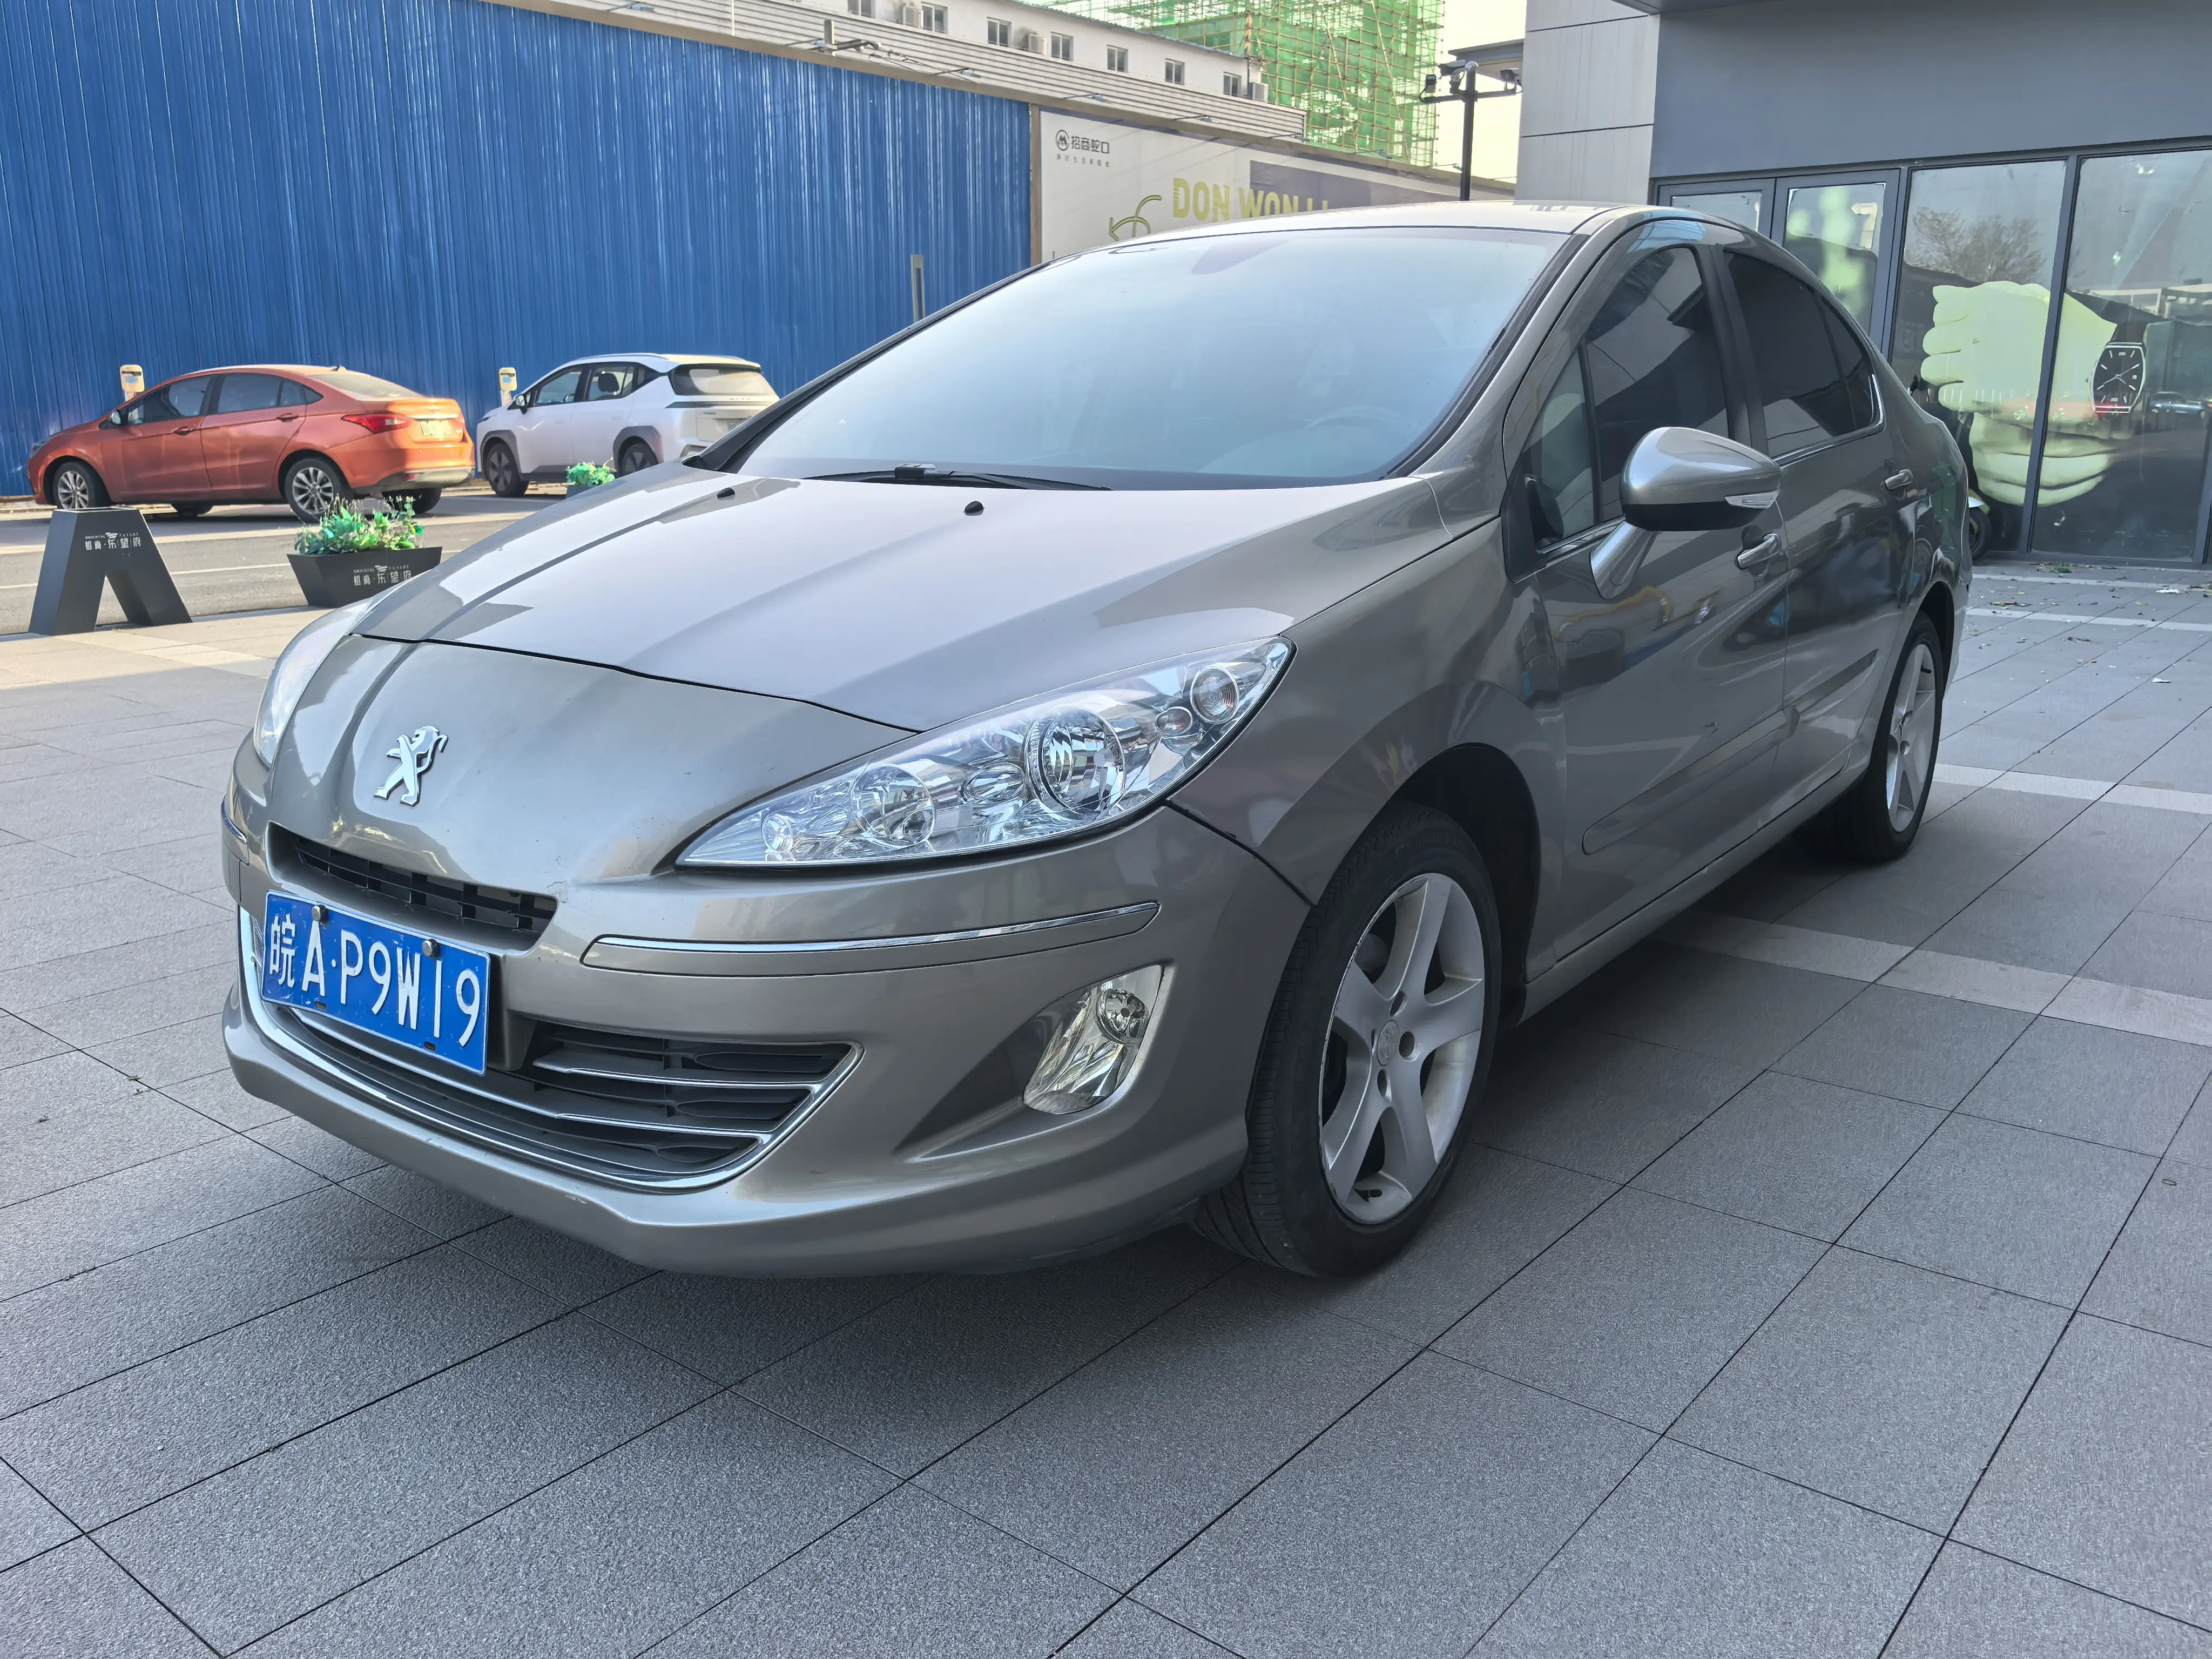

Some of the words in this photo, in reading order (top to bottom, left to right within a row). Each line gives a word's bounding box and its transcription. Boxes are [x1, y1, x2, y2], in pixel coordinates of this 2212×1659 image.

[1071, 136, 1110, 154] 招商蛇口
[1173, 177, 1230, 222] DON
[1239, 187, 1299, 219] WON
